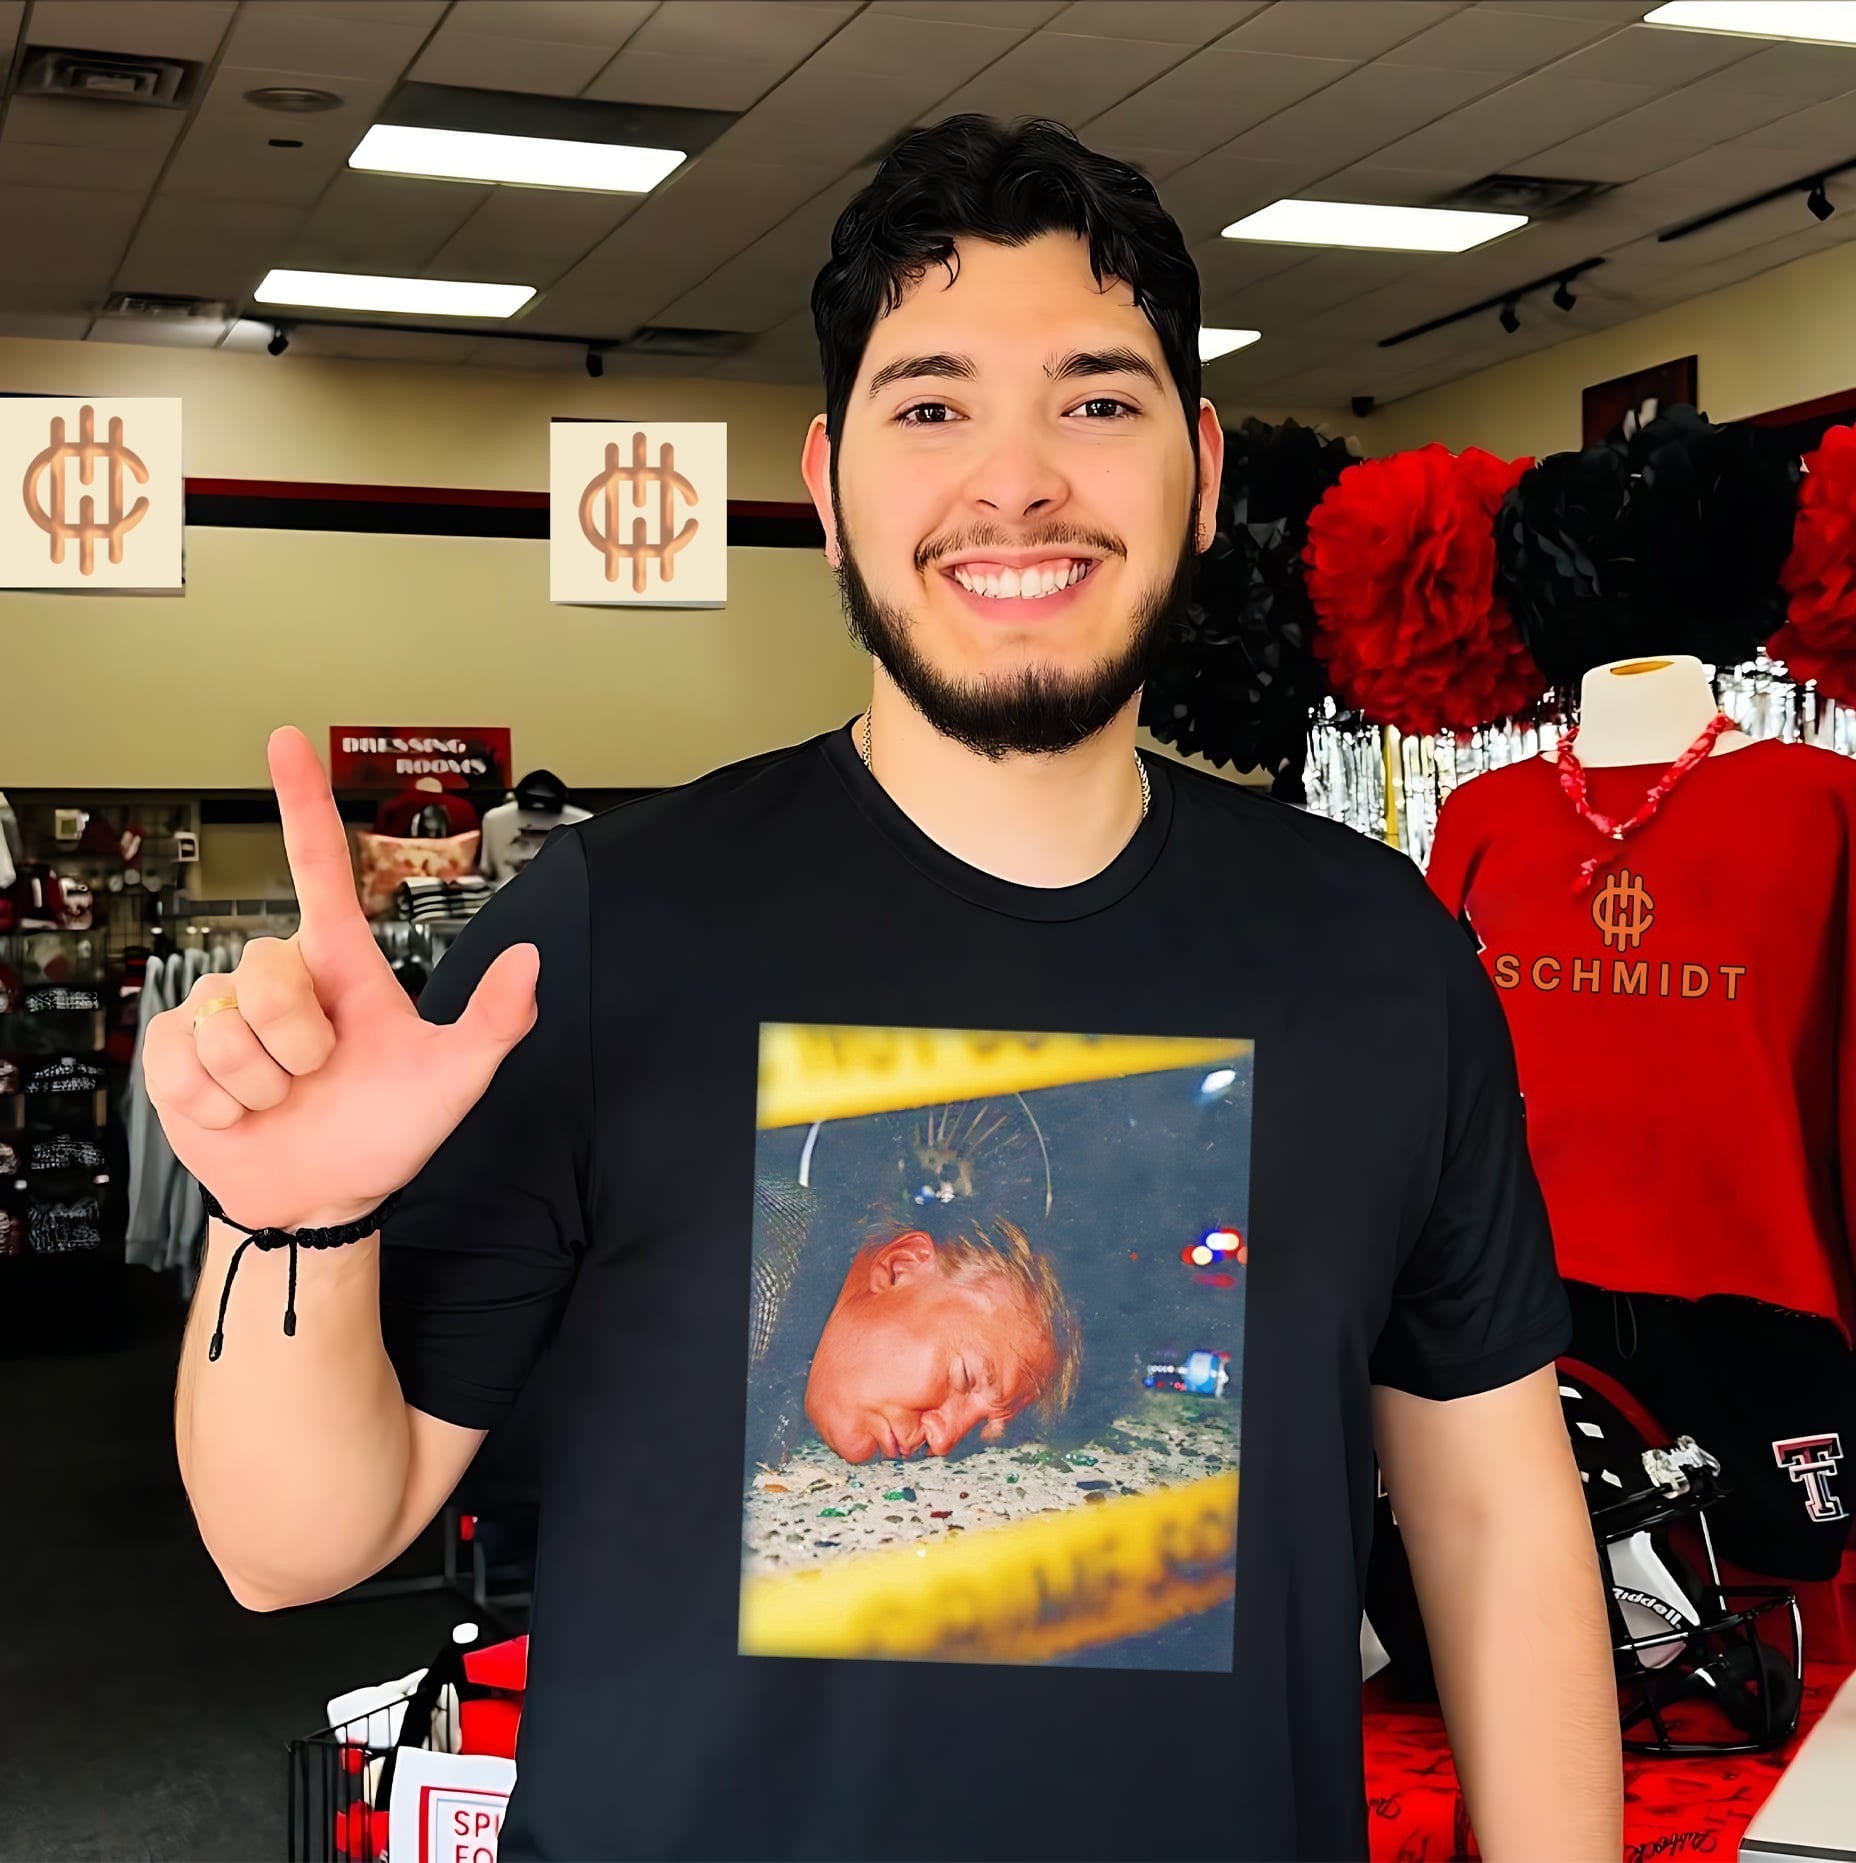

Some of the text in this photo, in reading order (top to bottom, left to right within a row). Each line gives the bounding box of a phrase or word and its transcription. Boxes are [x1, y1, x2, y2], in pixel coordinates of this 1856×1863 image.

[342, 737, 467, 754] DRESSING
[396, 758, 487, 775] ROOMS
[1494, 954, 1747, 1000] SCHMIDT
